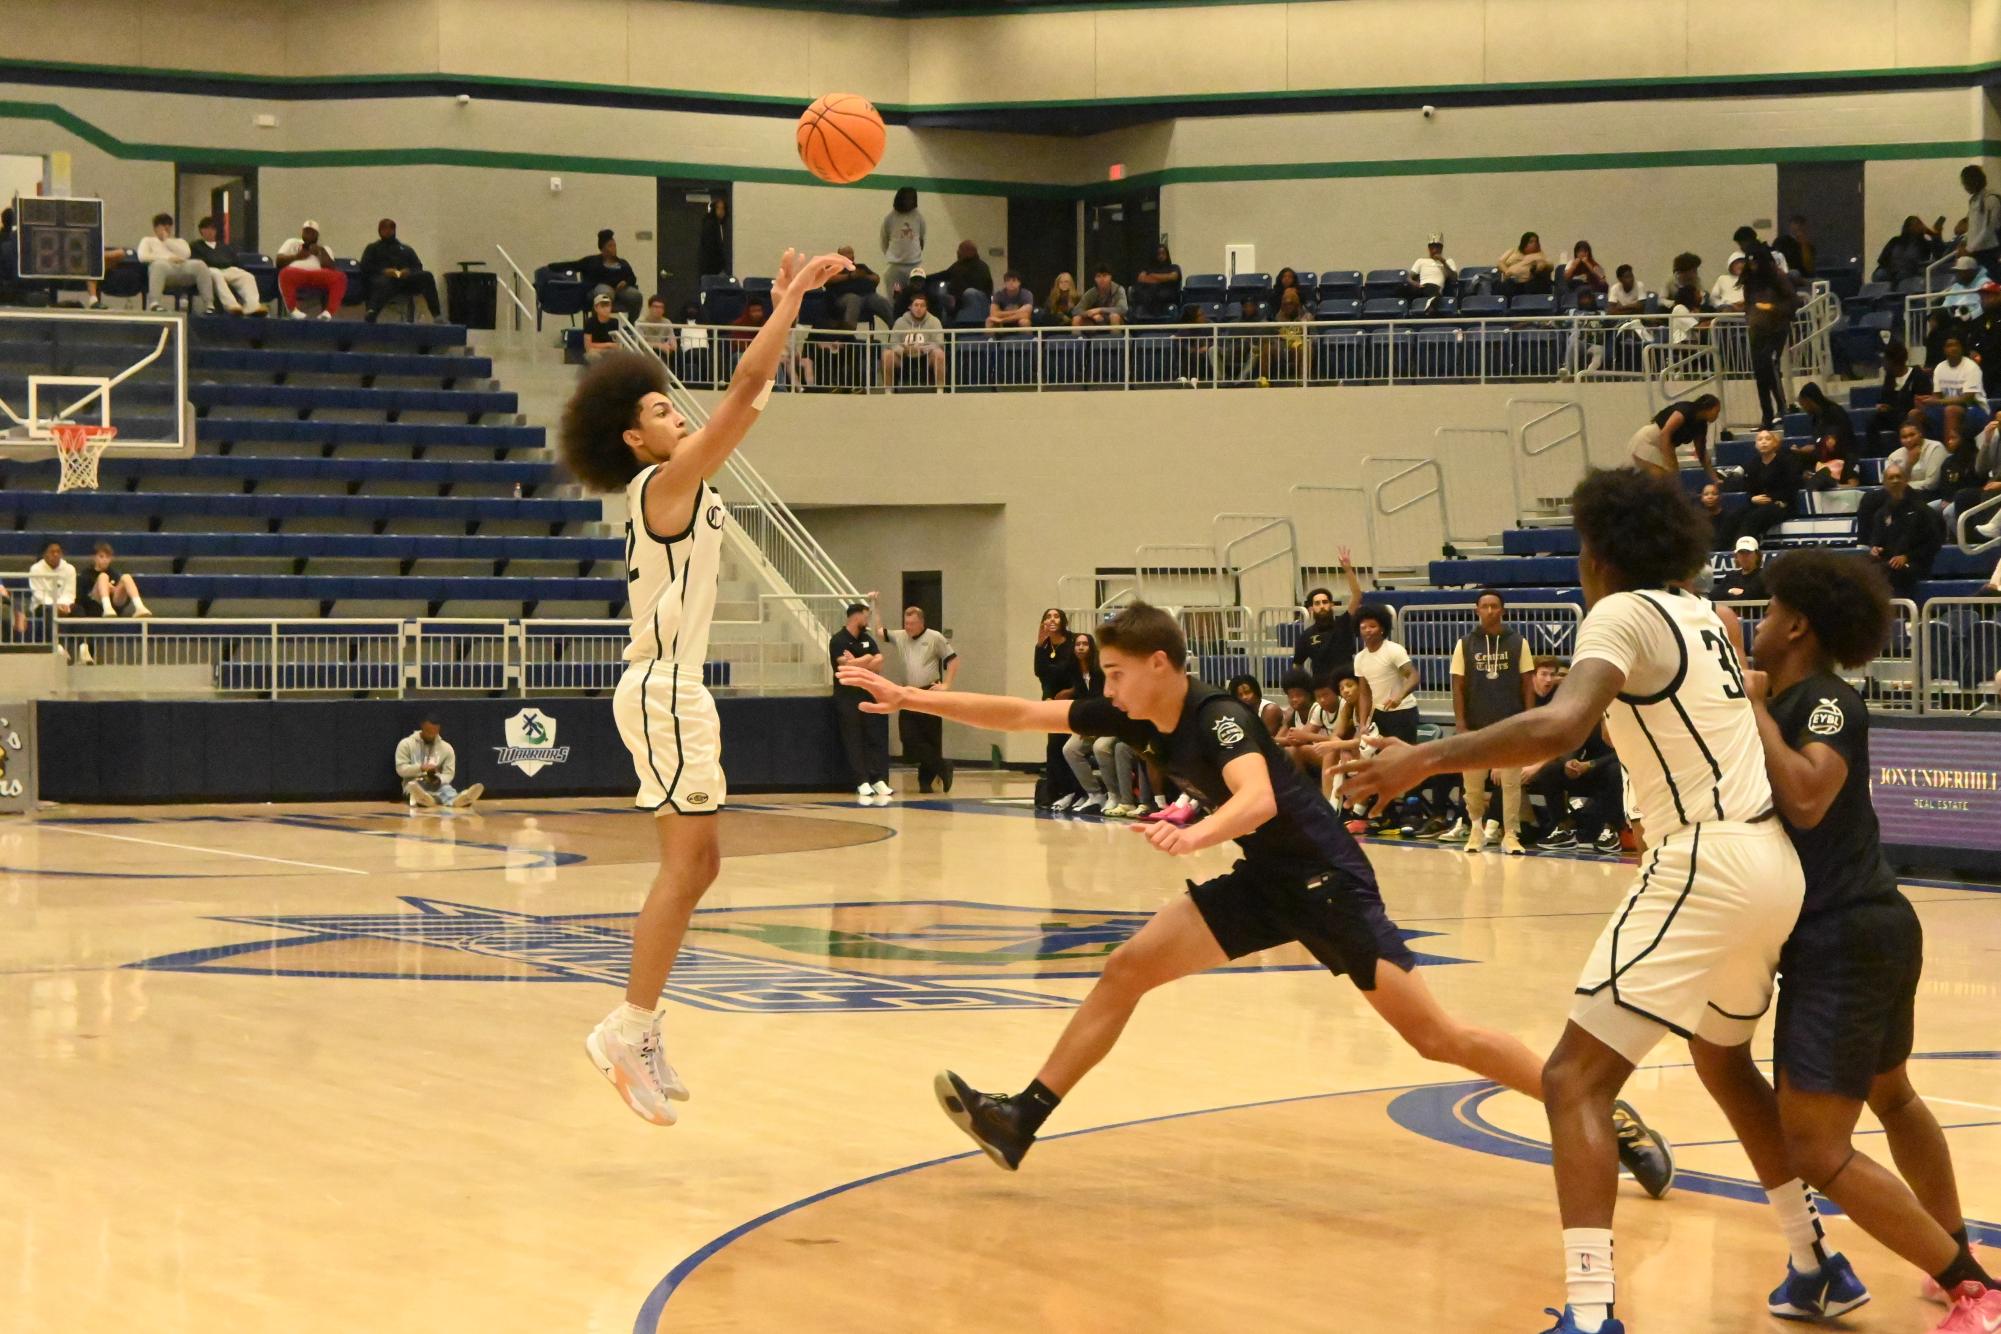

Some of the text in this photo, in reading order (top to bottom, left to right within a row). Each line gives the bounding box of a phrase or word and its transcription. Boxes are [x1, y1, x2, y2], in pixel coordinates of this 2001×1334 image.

[1812, 713, 1839, 726] EYBL
[492, 746, 570, 764] WARRIORS
[1880, 767, 1907, 786] JON
[1914, 798, 1969, 811] REAL ESTATE
